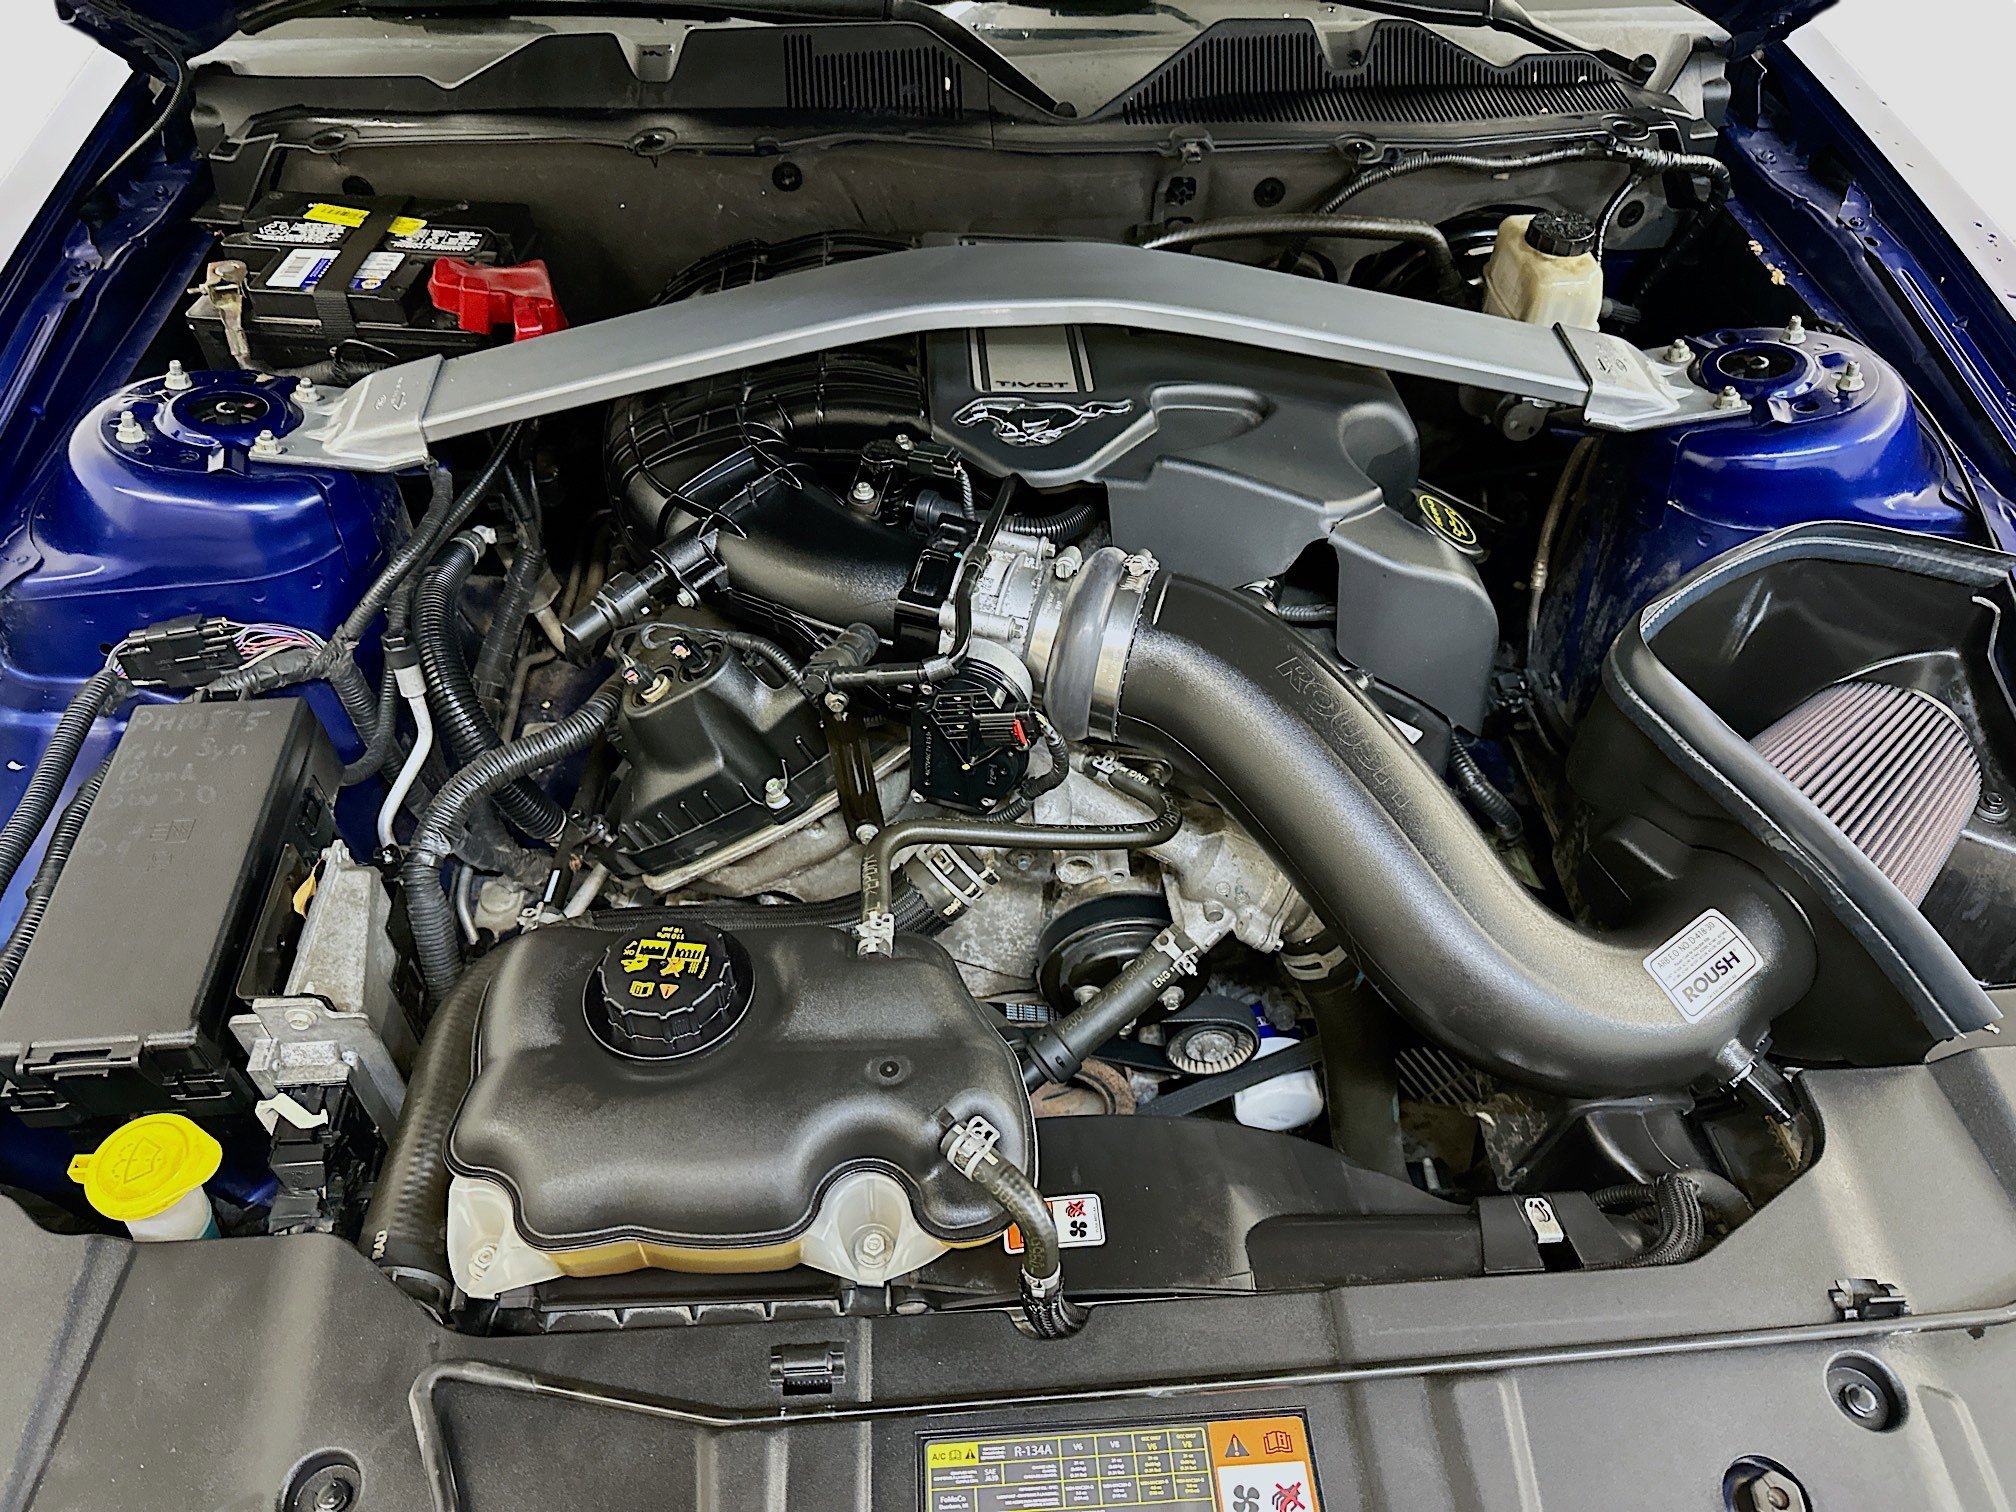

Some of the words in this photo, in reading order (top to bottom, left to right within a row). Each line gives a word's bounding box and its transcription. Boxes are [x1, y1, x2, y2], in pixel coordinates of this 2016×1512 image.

[1152, 969, 1171, 989] ENG
[1682, 950, 1741, 1003] ROUSH
[932, 1452, 946, 1461] A/C
[1014, 1444, 1053, 1458] R-134A
